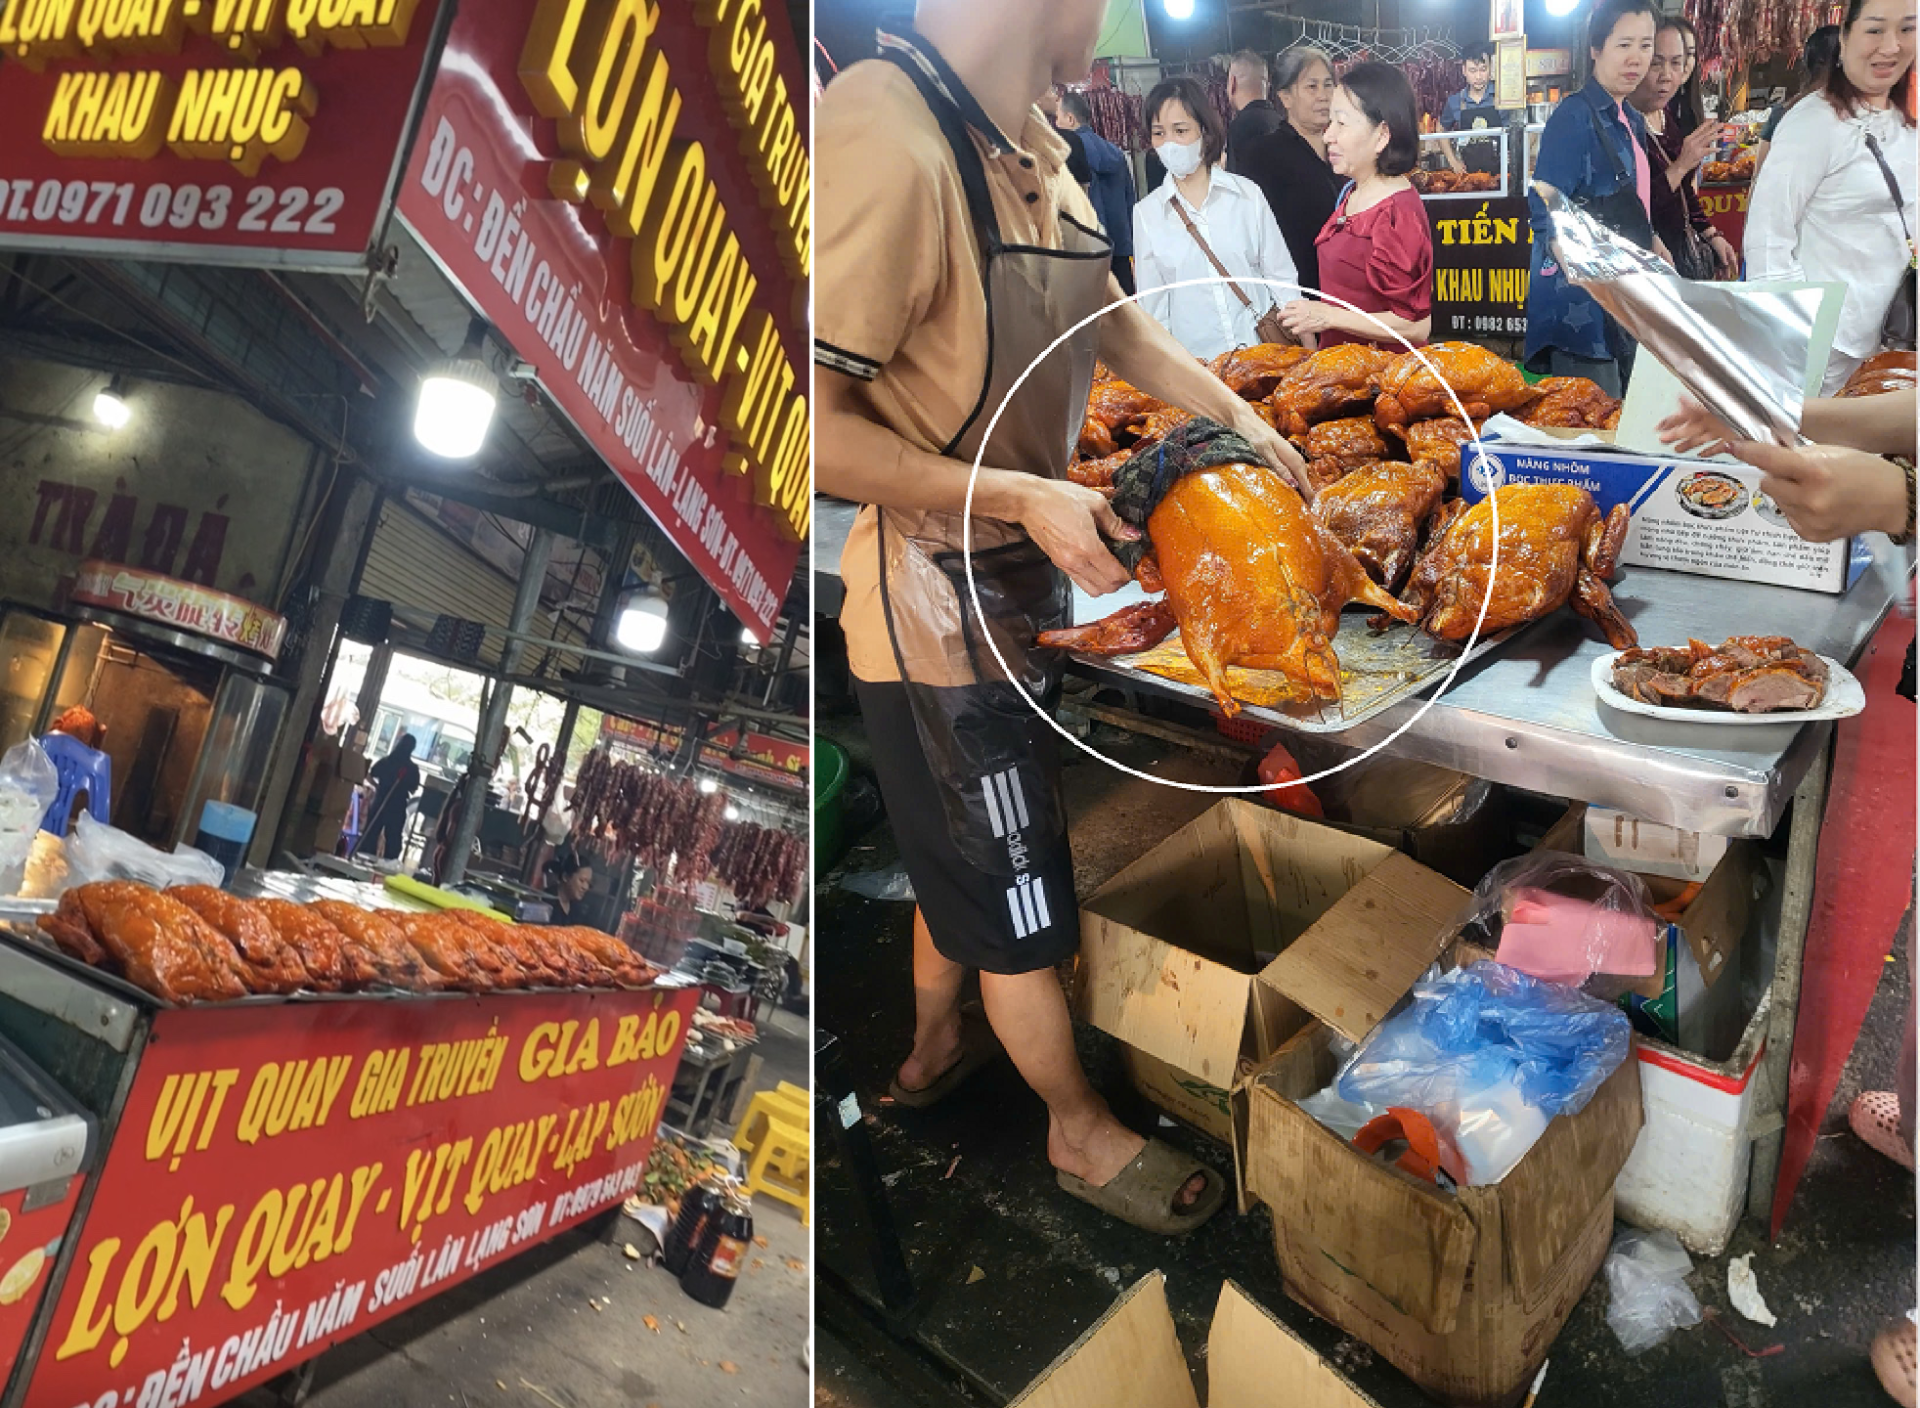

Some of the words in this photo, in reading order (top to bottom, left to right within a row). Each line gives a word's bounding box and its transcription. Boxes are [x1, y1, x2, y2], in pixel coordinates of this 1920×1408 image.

[42, 71, 162, 143] KHAU
[167, 67, 302, 160] NHỤC
[139, 183, 233, 230] 093
[237, 187, 345, 234] 222
[1436, 201, 1519, 244] TIẾN
[474, 188, 536, 305] ĐỀN
[525, 260, 588, 371] CHẦU
[577, 319, 624, 424] NĂM
[615, 385, 657, 465] SUỐI
[655, 141, 757, 382] QUAY
[737, 312, 795, 474] VỊT
[1436, 269, 1483, 301] KHAU
[1489, 269, 1530, 310] NHỤ
[146, 1068, 240, 1172] VỊT
[237, 1055, 352, 1145] QUAY
[350, 1047, 410, 1118] GIA
[406, 1016, 509, 1106] TRUYỀN
[519, 1017, 599, 1082] GIA
[56, 1195, 235, 1368] LỢN
[221, 1162, 382, 1310] QUAY
[400, 1136, 473, 1244] VỊT
[464, 1114, 557, 1216] QUAY
[210, 1299, 300, 1390] CHẦU
[296, 1279, 366, 1349] NĂM
[368, 1240, 425, 1313] SUỐI
[420, 1234, 466, 1288] LÂN
[464, 1215, 514, 1271] LẠNG
